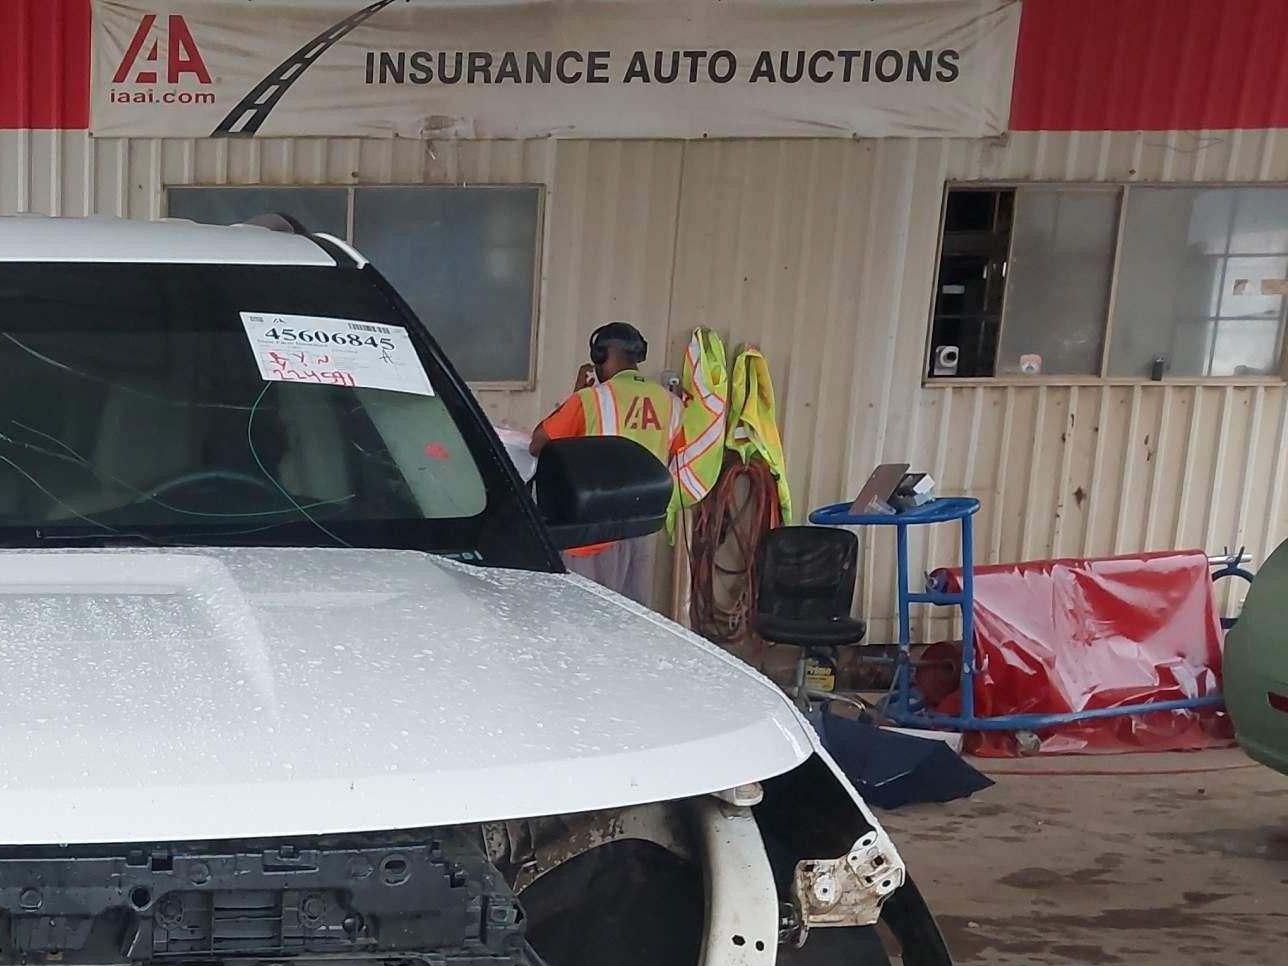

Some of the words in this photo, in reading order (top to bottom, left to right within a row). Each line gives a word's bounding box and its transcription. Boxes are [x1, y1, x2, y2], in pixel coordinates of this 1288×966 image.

[365, 49, 611, 84] INSURANCE
[623, 50, 738, 84] AUTO
[749, 49, 961, 84] AUCTIONS
[110, 88, 216, 104] iaai.com
[265, 327, 395, 351] 45606845
